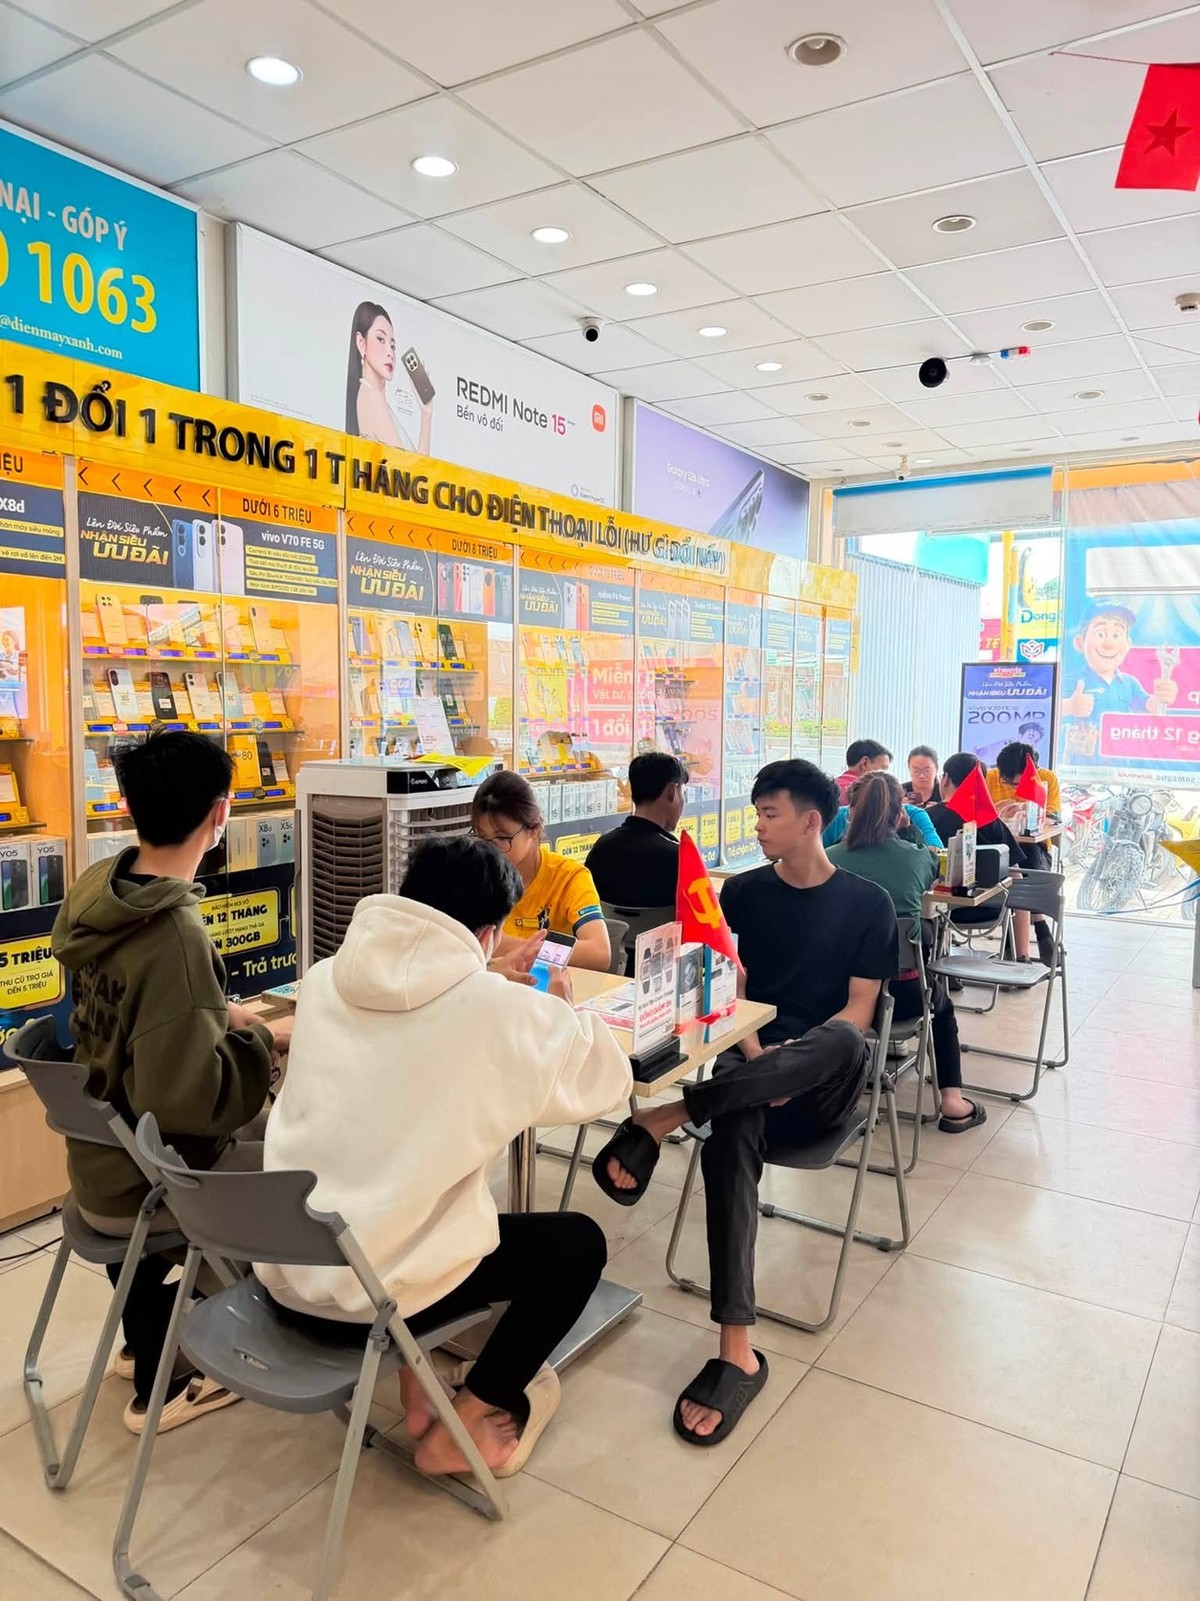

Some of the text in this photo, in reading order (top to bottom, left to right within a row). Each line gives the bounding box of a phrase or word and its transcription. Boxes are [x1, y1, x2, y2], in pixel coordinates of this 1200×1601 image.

[62, 205, 110, 243] GÓP
[114, 220, 128, 250] Ý
[456, 376, 567, 435] REDMI Note 15
[456, 404, 504, 432] Bền vô đối
[6, 374, 24, 414] 1
[42, 380, 126, 438] ĐỔI
[139, 408, 156, 444] 1
[168, 411, 296, 474] TRONG
[305, 449, 318, 479] 1
[434, 481, 484, 518] CHO
[487, 494, 536, 533] ĐIỆN
[536, 505, 592, 548] THOẠI
[596, 516, 622, 549] LỖI
[242, 498, 312, 525] DƯỚI 6 TRIỆU
[80, 529, 118, 543] NHẬN
[261, 530, 325, 550] vivo V70 FE 5G
[93, 541, 169, 565] ƯU ĐÃI
[452, 538, 498, 560] DƯỚI 8 TRIỆU
[350, 564, 382, 579] NHẬN
[391, 581, 425, 601] ĐÃI
[217, 911, 227, 924] 12
[226, 931, 260, 948] 300GB
[11, 946, 52, 966] TRIỆU
[243, 953, 268, 978] Trả
[22, 984, 28, 992] 5
[28, 981, 47, 992] TRIỆU
